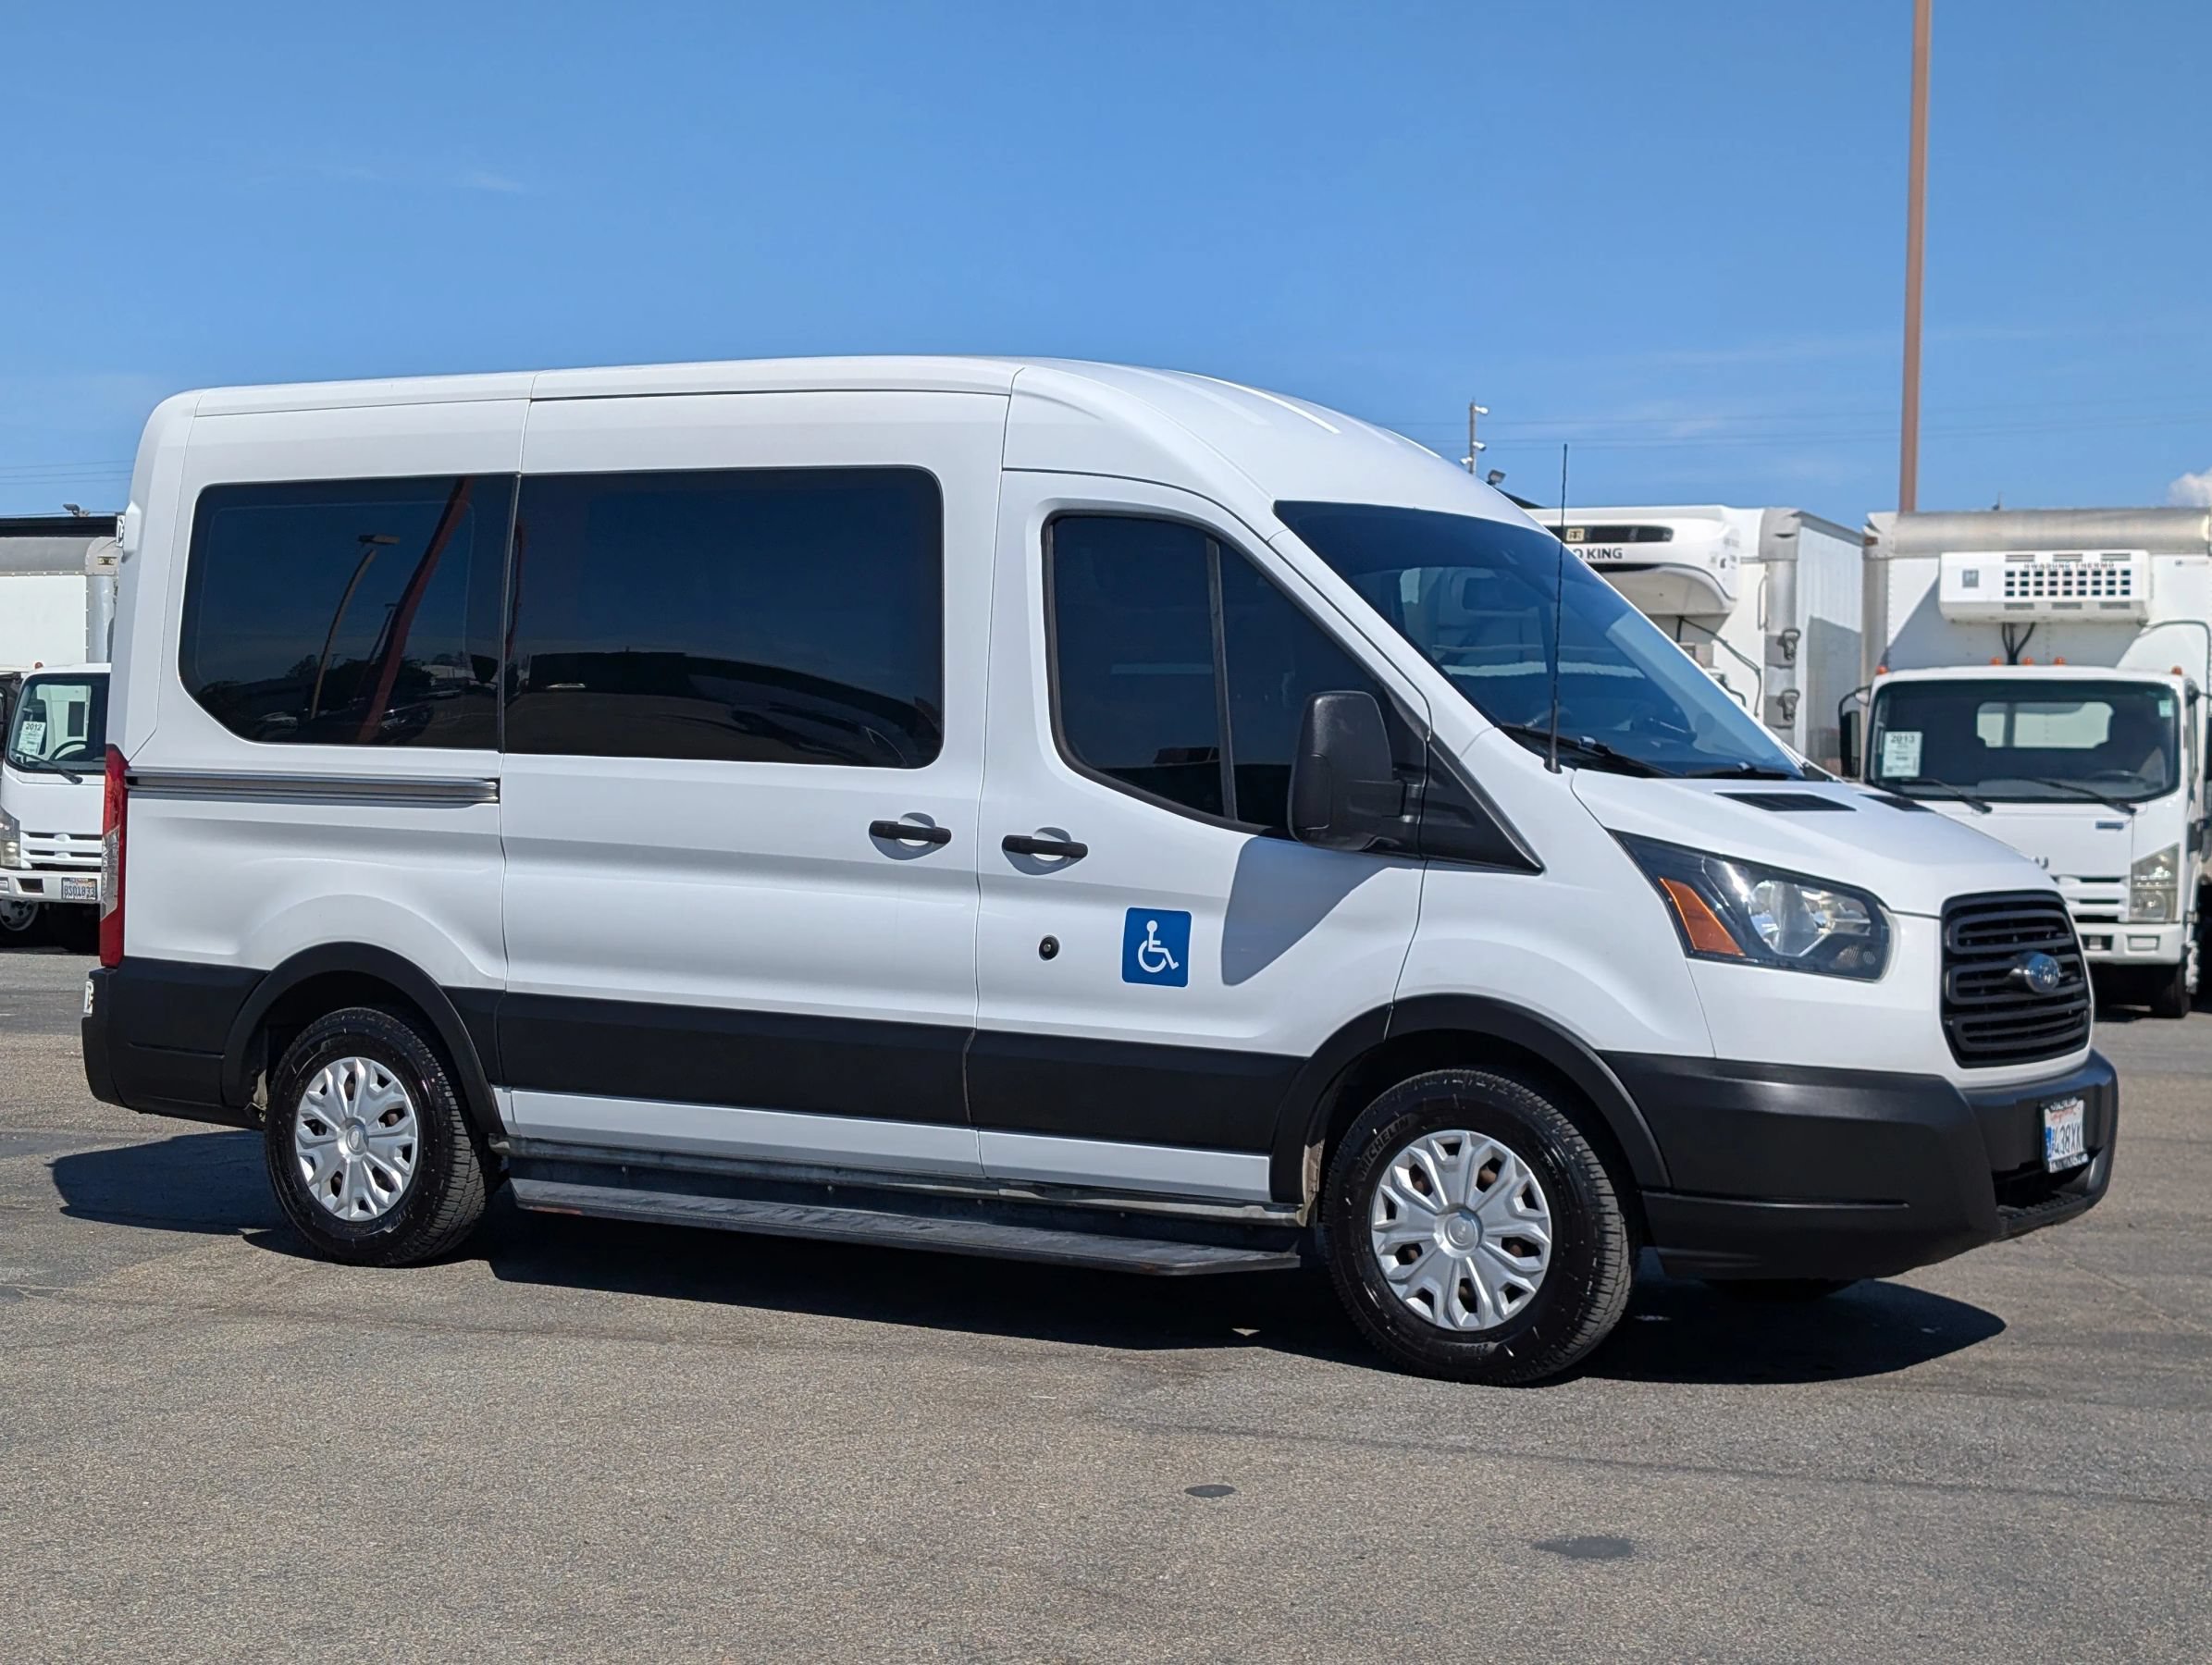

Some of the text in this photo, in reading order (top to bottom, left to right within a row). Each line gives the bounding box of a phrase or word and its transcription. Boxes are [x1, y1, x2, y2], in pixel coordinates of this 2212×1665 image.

[1587, 548, 1623, 559] KING
[25, 722, 43, 731] 2012
[1890, 735, 1915, 744] 2013
[1359, 1114, 1409, 1181] MICHELIN
